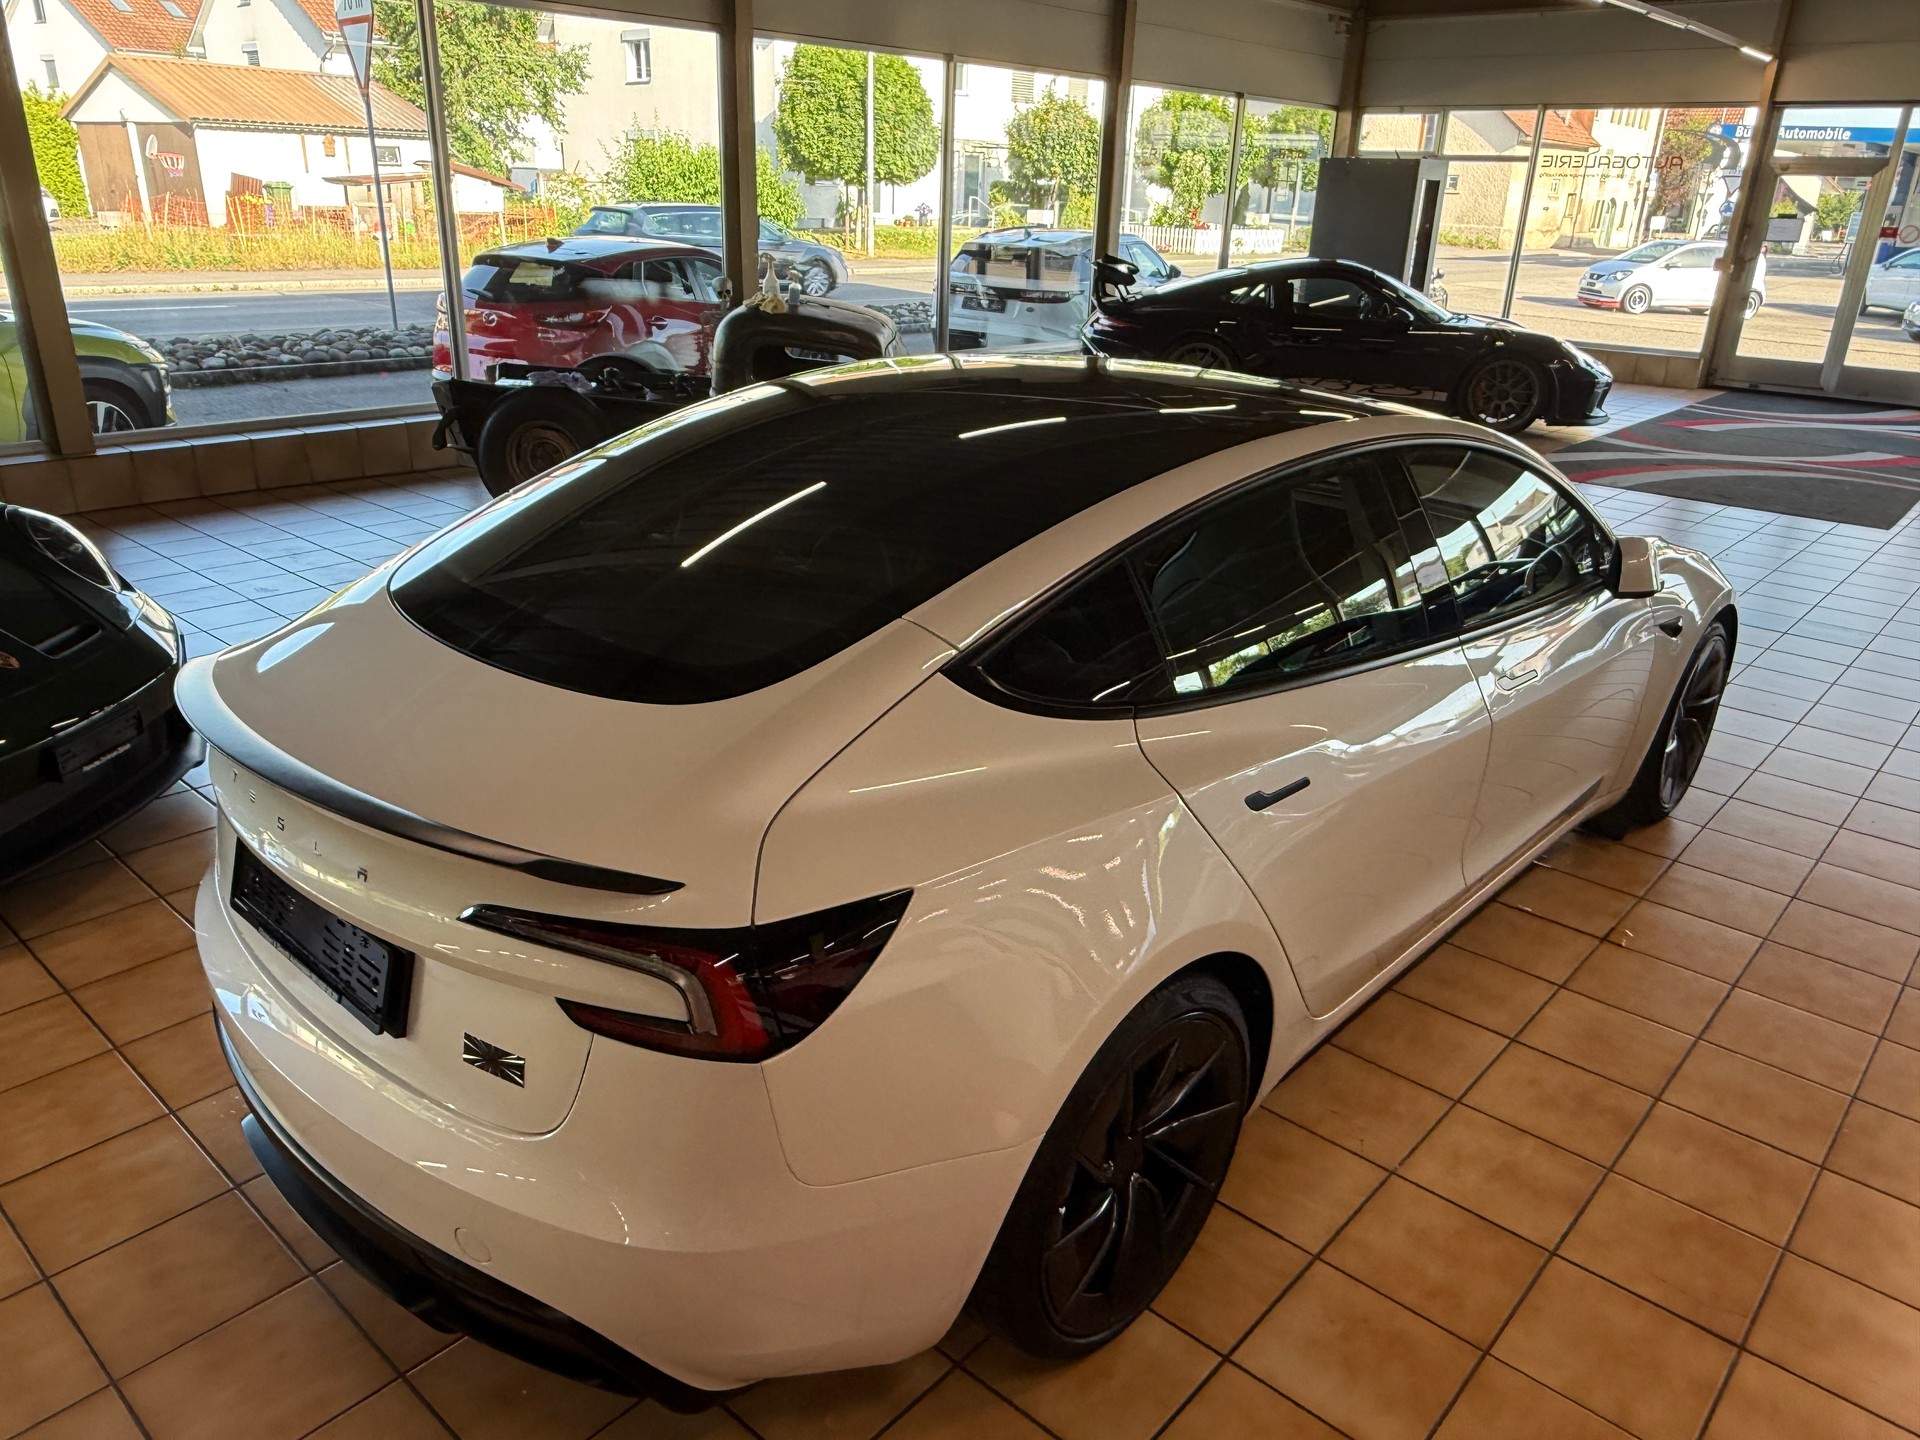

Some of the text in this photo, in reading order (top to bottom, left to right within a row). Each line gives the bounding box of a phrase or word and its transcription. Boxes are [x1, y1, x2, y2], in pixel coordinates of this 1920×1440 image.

[1735, 125, 1851, 141] Bü Automobile
[232, 768, 369, 883] TESLA
